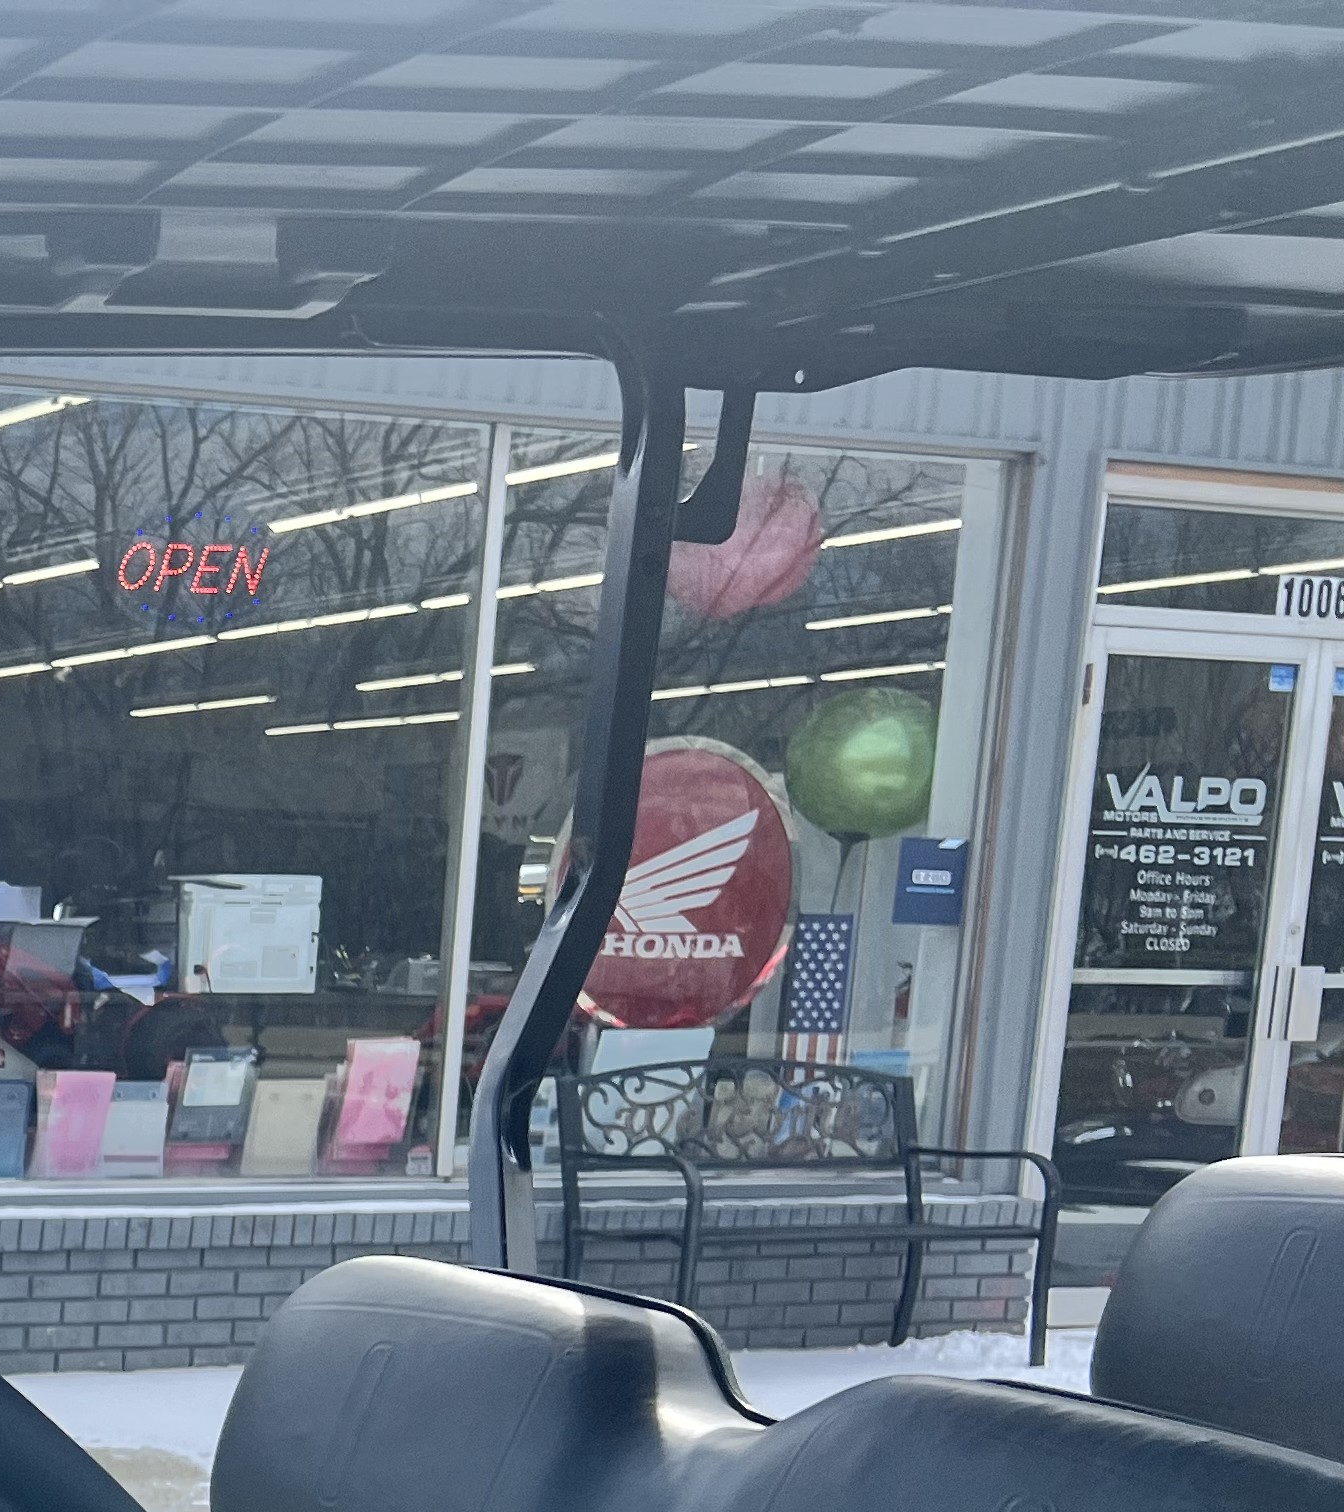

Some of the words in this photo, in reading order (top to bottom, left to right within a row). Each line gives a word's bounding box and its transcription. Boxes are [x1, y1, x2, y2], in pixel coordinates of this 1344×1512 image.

[117, 541, 269, 596] OPEN
[1106, 761, 1267, 815] VALPO
[1103, 810, 1159, 823] MOTORS
[1130, 827, 1163, 839] PARTS
[1164, 829, 1187, 840] AND
[1189, 830, 1231, 841] SERVICE
[1137, 869, 1172, 885] Office
[1175, 871, 1211, 886] Hours
[1165, 907, 1177, 919] to
[1121, 920, 1169, 935] Saturday
[1179, 921, 1218, 937] Sunday
[601, 933, 745, 959] HONDA
[1145, 937, 1190, 951] CLOSED
